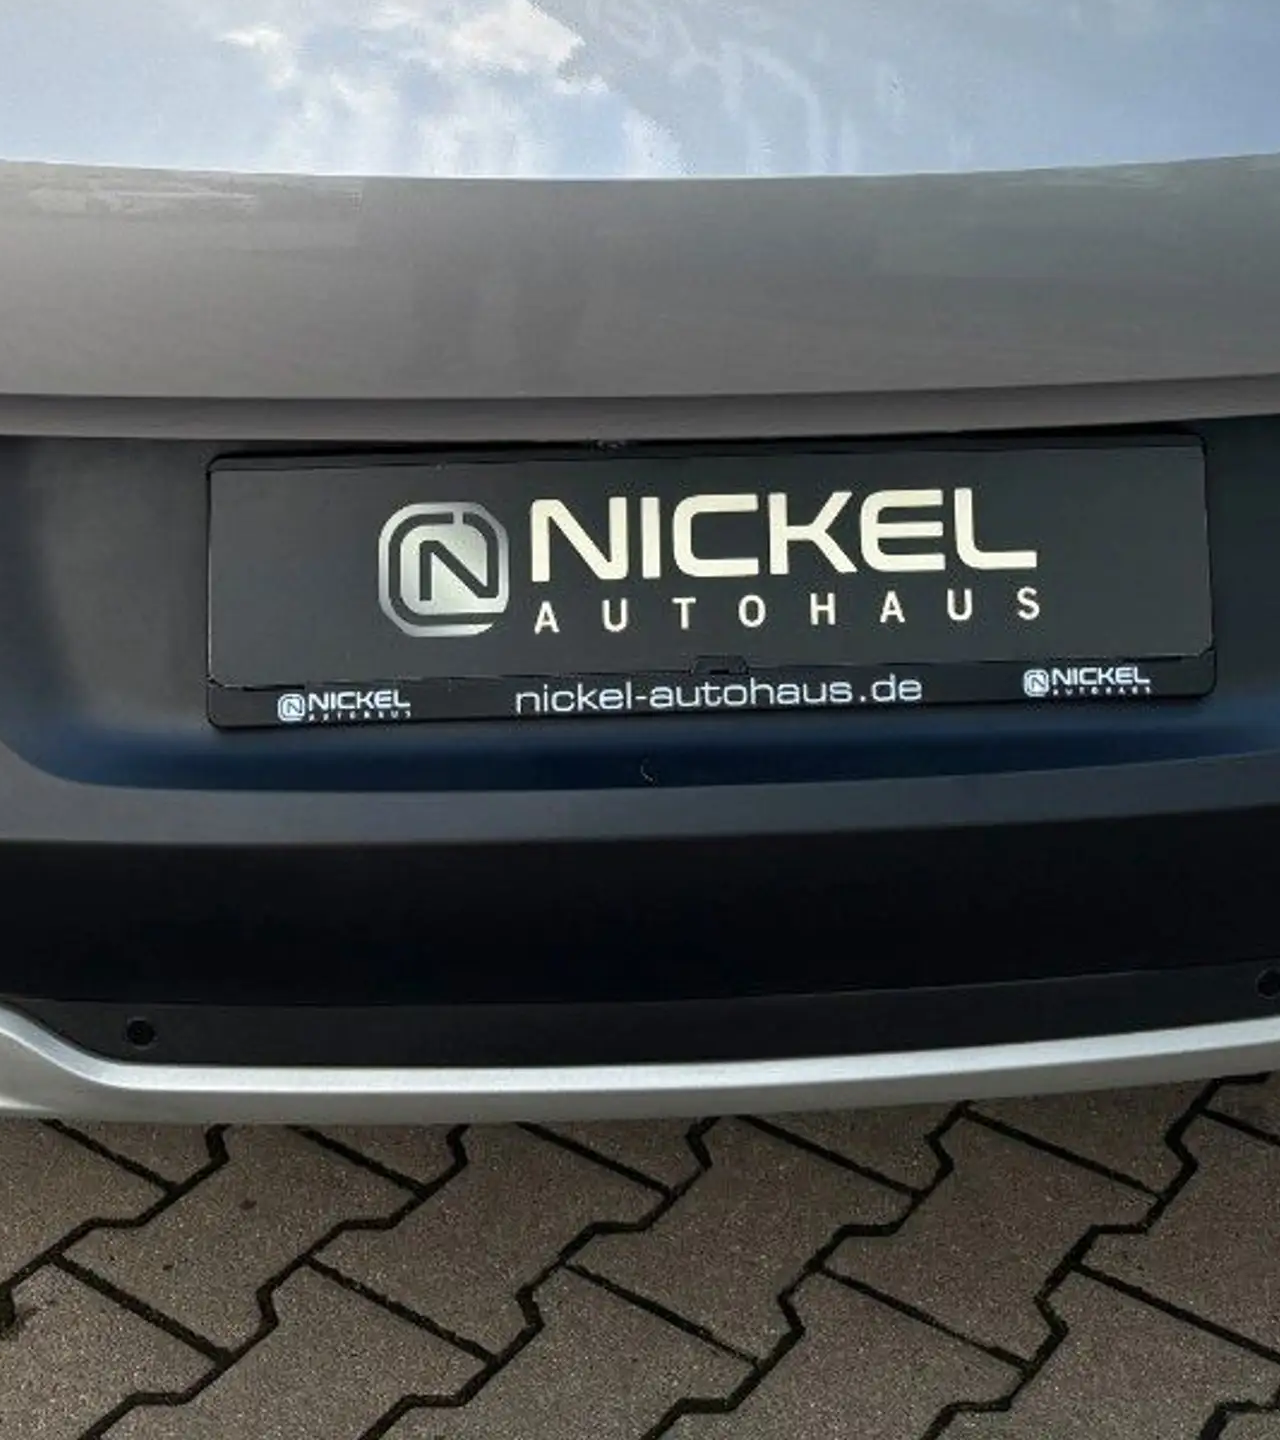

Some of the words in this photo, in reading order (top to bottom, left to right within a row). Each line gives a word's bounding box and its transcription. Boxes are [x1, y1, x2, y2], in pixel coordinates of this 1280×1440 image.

[530, 486, 1038, 582] NICKEL
[534, 586, 1041, 635] AUTOHAUS
[516, 673, 922, 714] nickel-autohaus.de
[1052, 666, 1151, 685] NICKEL
[308, 689, 411, 711] NICKEL
